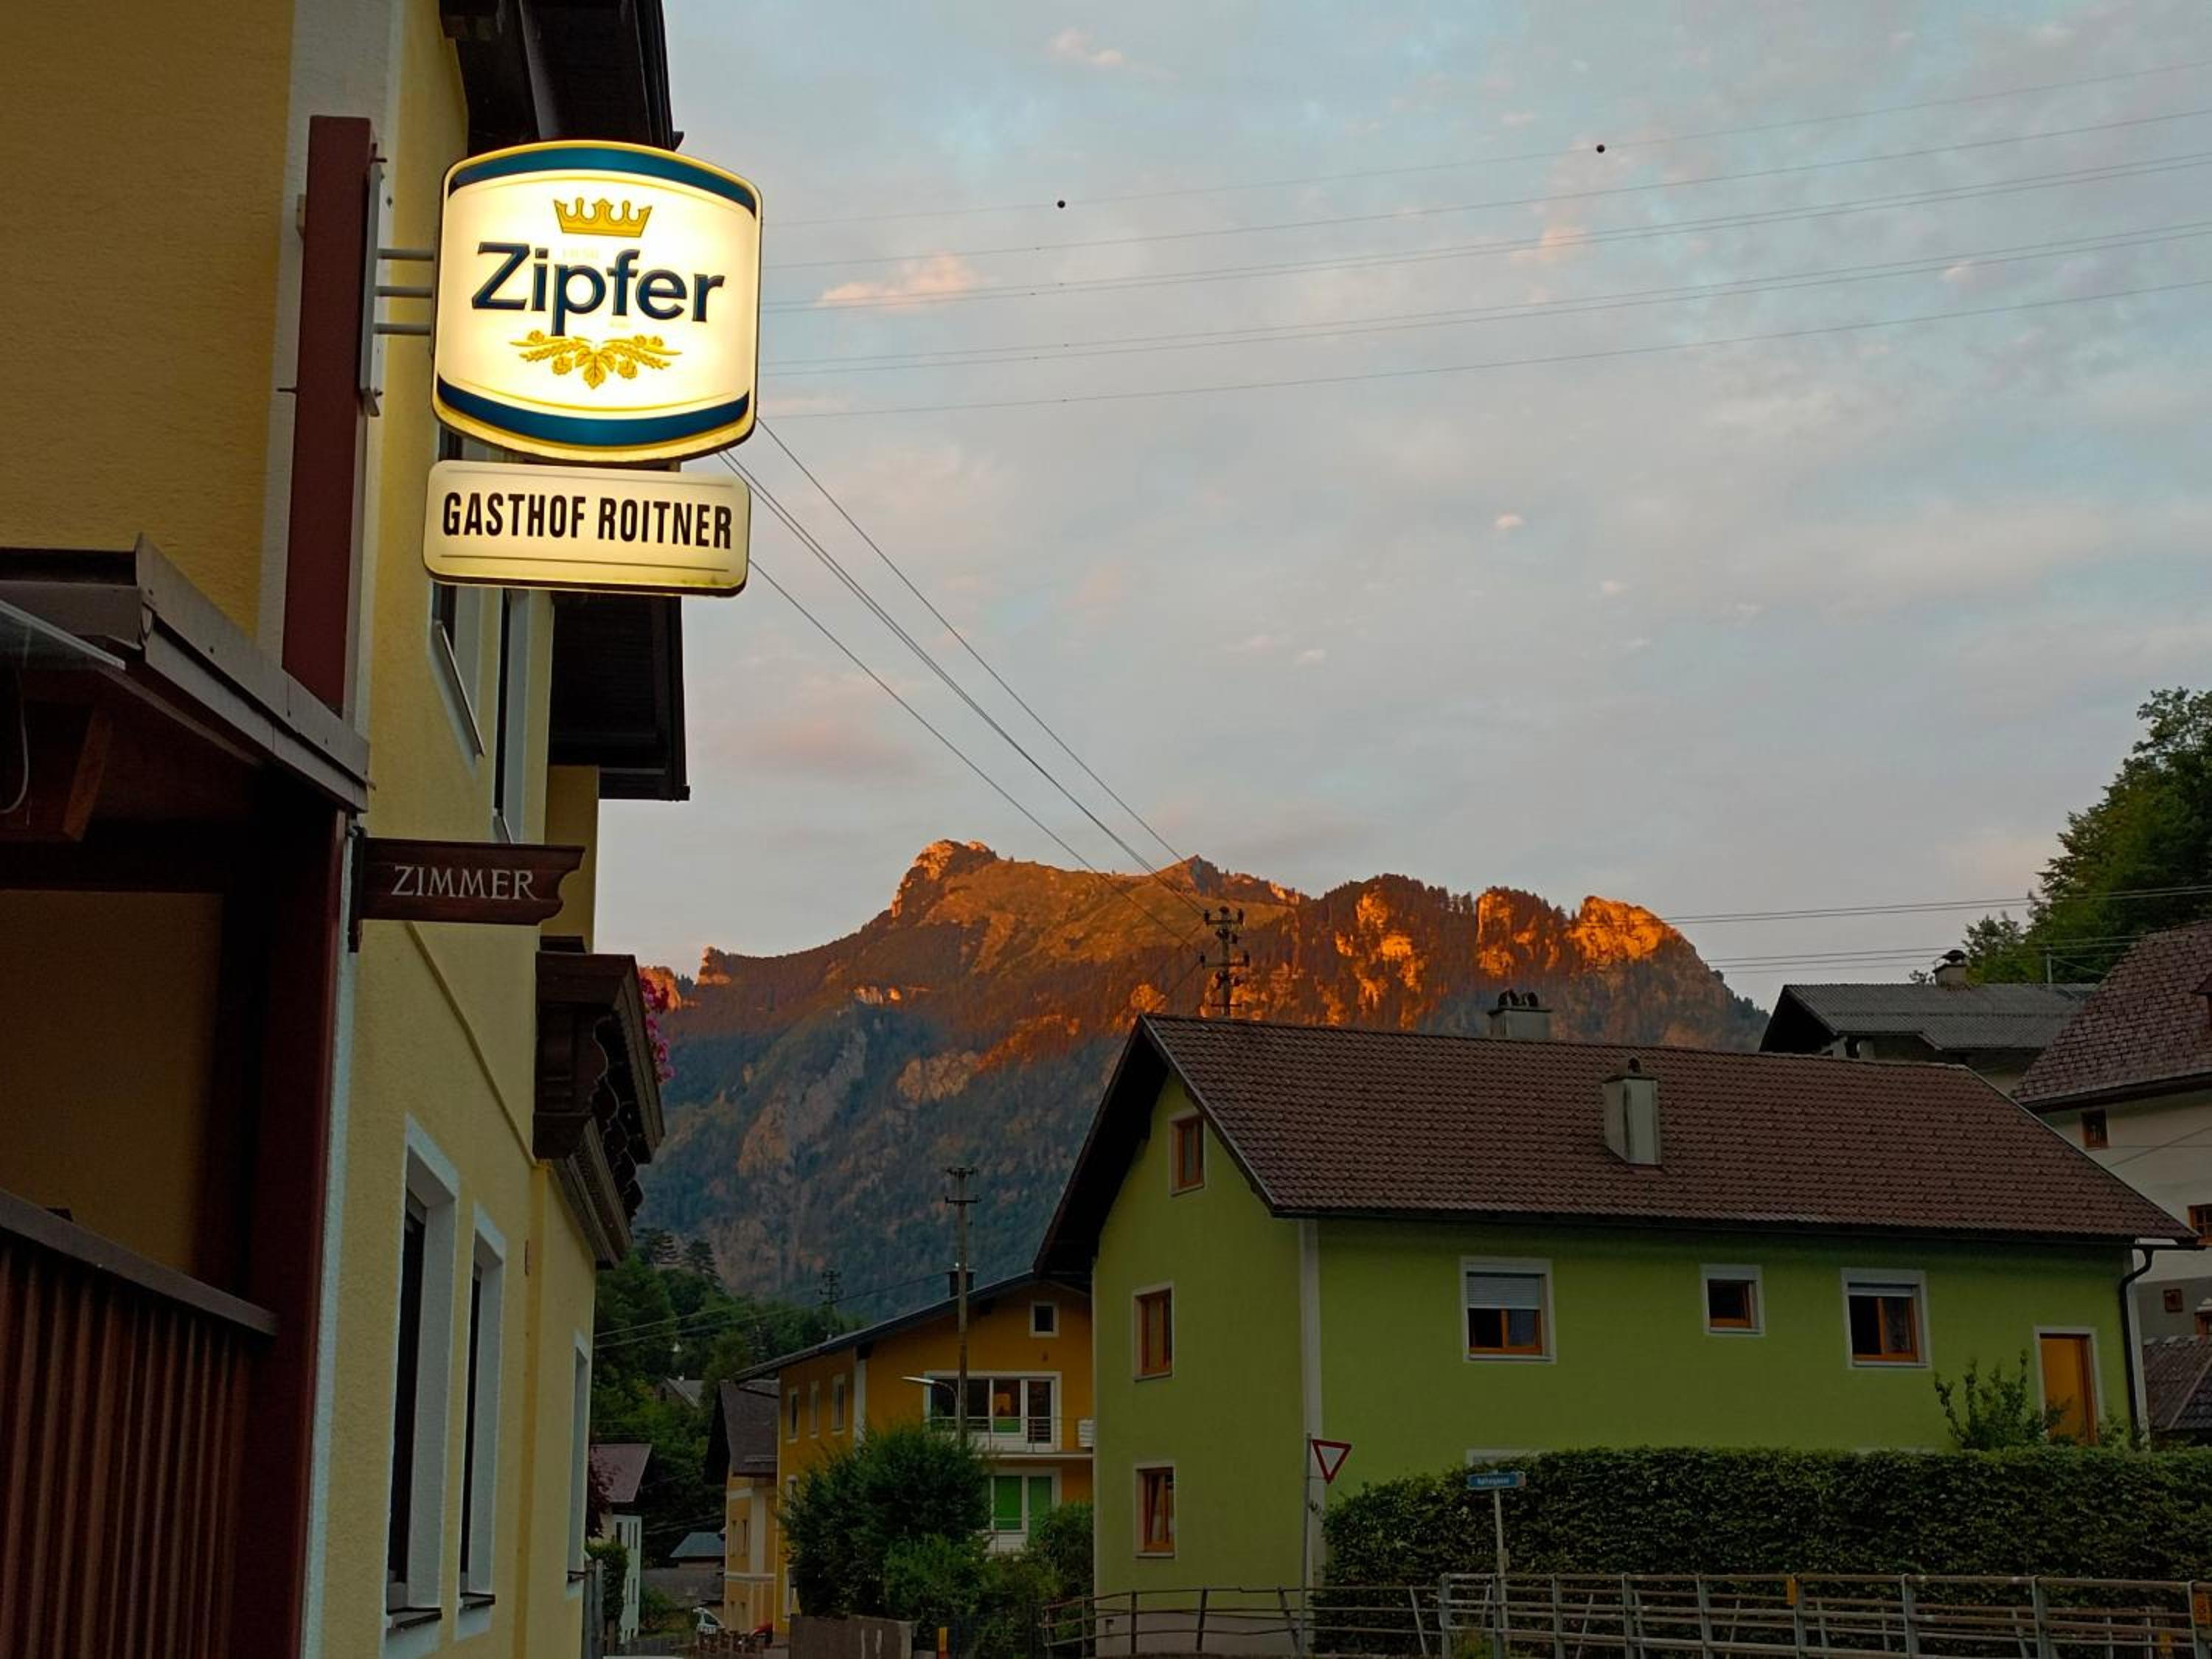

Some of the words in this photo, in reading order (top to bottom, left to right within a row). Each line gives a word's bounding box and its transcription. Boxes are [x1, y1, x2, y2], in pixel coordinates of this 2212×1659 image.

[471, 241, 726, 338] Zipfer
[442, 491, 587, 539] GASTHOF
[597, 497, 732, 550] ROITNER
[391, 865, 541, 901] ZIMMER
